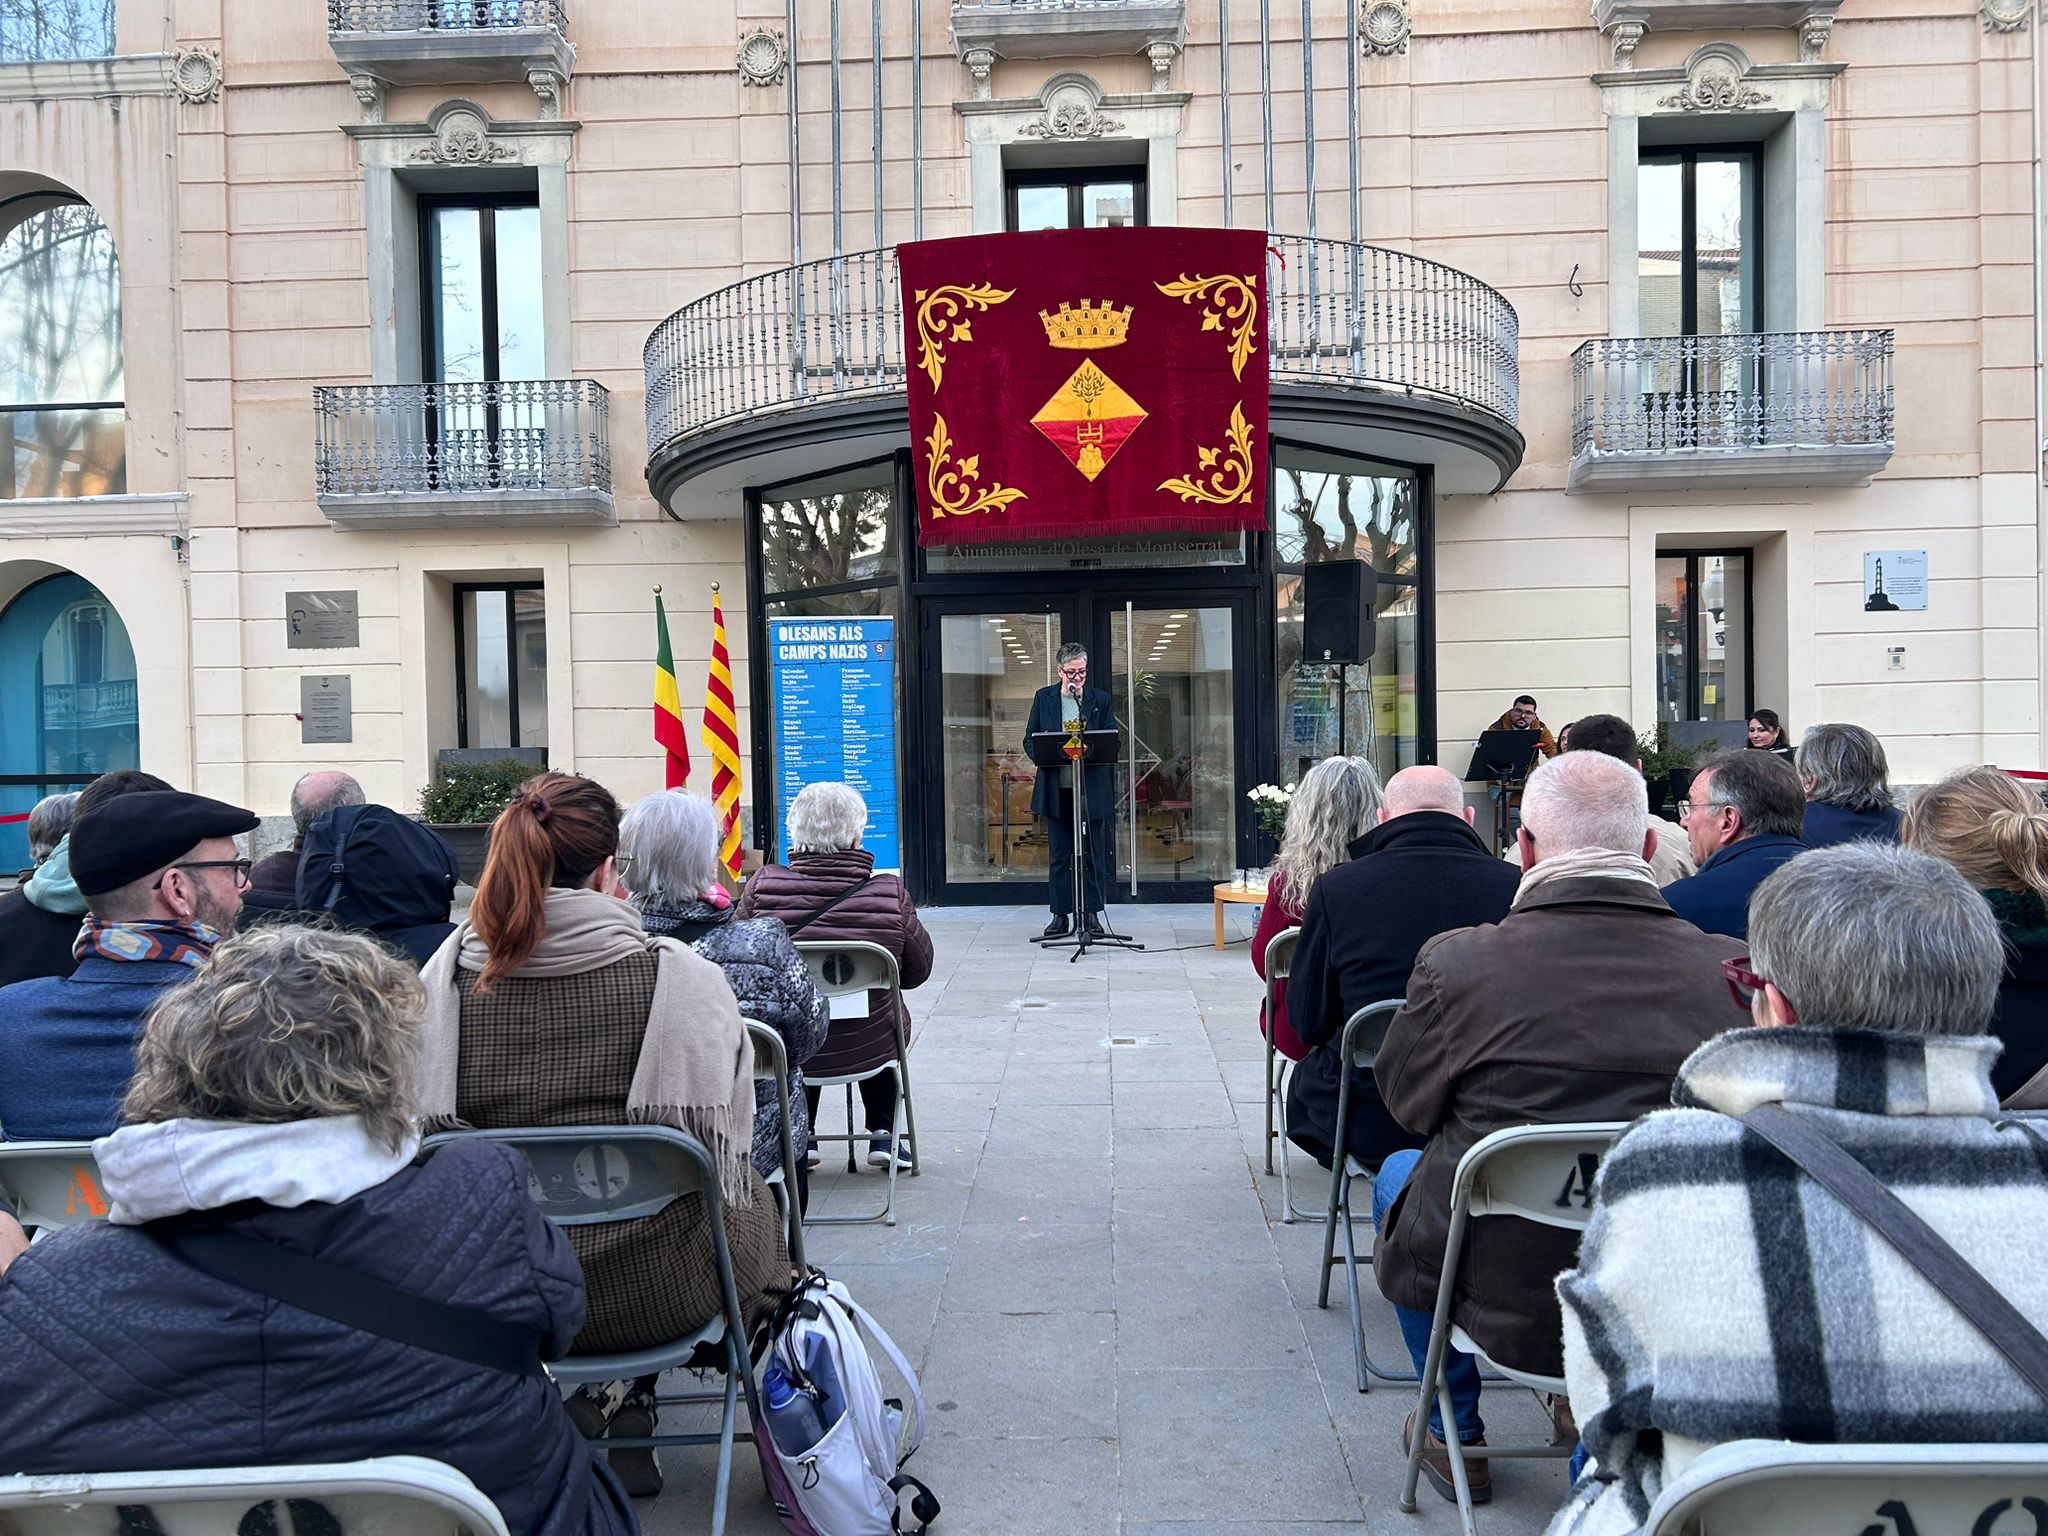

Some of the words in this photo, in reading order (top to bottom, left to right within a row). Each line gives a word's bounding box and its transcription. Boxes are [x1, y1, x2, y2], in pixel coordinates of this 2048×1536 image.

[951, 544, 1042, 563] Ajuntament
[1047, 541, 1105, 556] d'Olesa
[1111, 541, 1132, 554] de
[1135, 539, 1222, 553] Montserrat
[779, 626, 837, 641] OLESANS
[839, 626, 863, 641] ALS
[780, 644, 827, 660] CAMPS
[829, 644, 868, 659] NAZIS
[876, 644, 883, 653] S
